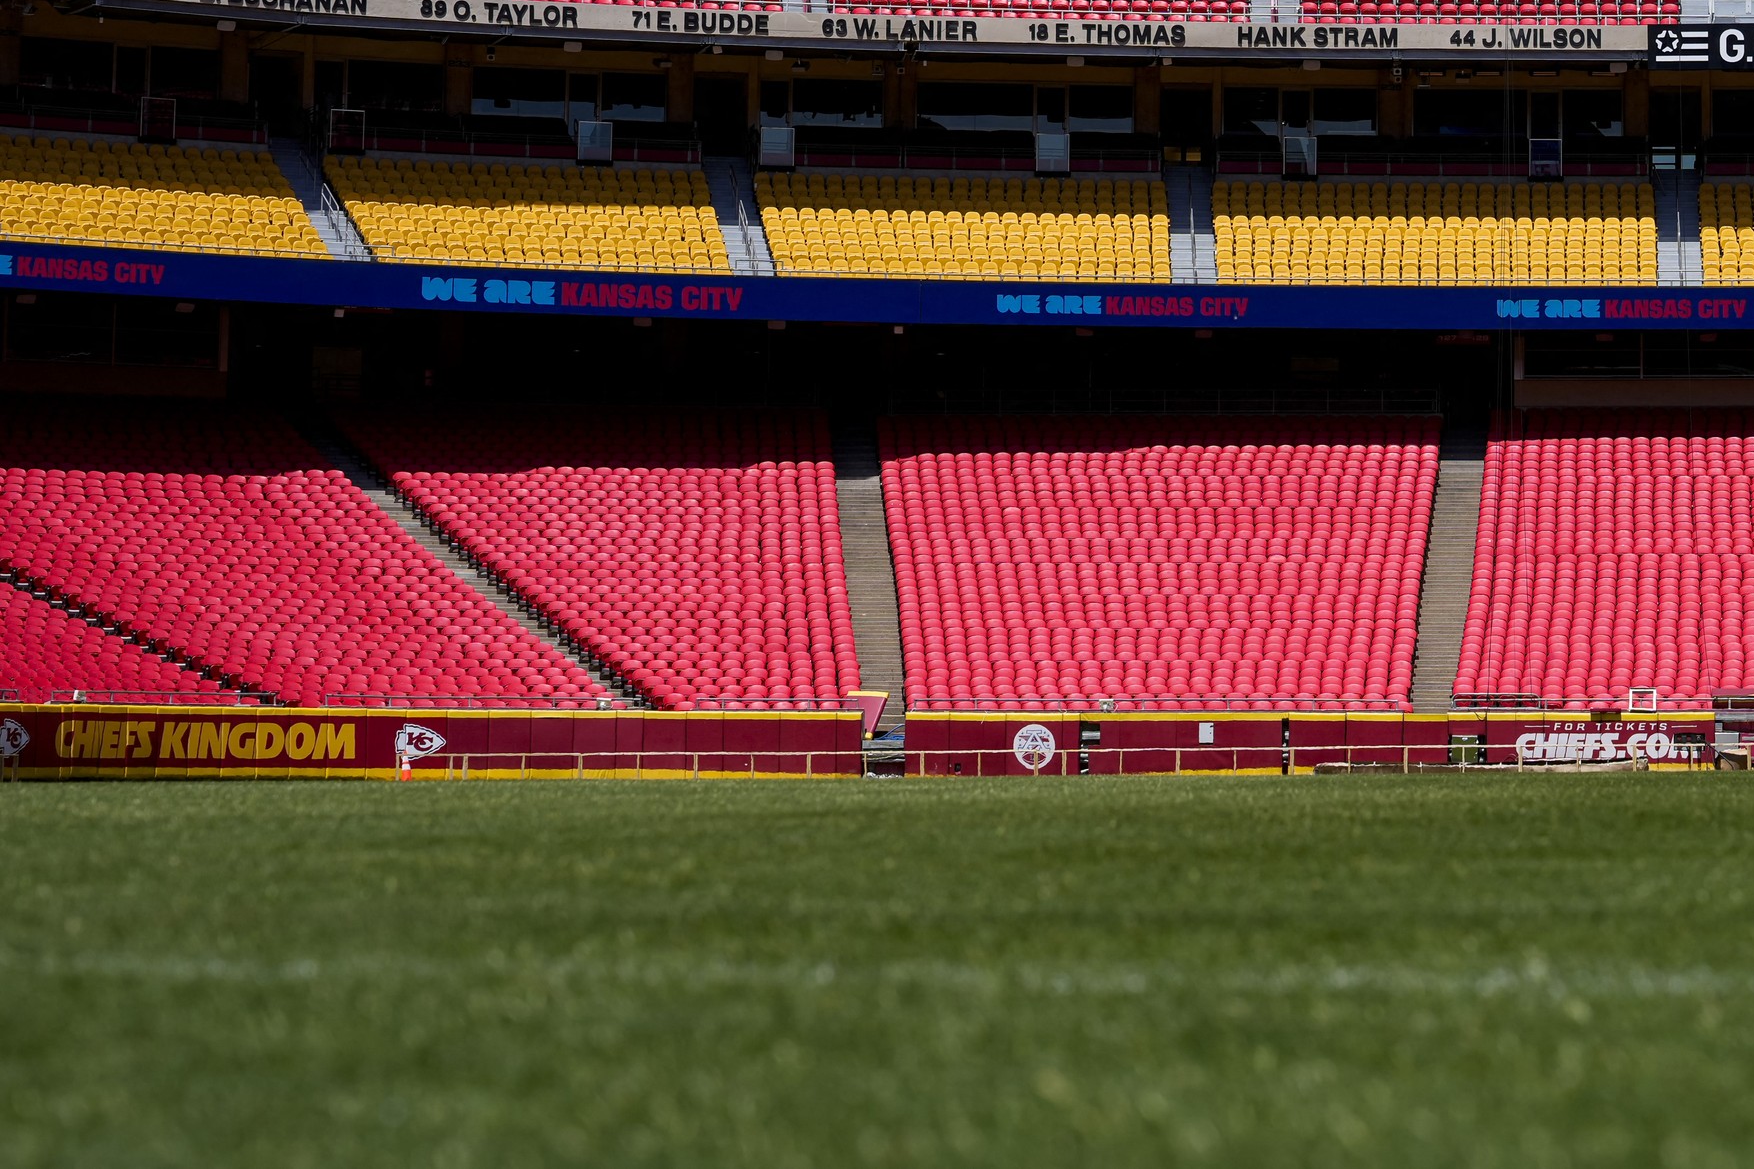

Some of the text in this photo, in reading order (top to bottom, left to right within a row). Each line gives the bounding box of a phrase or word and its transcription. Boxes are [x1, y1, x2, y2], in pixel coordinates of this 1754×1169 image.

[420, 0, 578, 28] 89 O. TAYLOR
[632, 10, 769, 36] 71 E. BUDDE
[822, 18, 978, 42] 63 W. LANIER
[1029, 23, 1186, 47] 18 E. THOMAS
[1237, 26, 1398, 49] HANK STRAM
[1449, 28, 1602, 49] 44 J. WILSON
[17, 255, 109, 282] KANSAS
[114, 261, 165, 285] CITY
[421, 276, 477, 303] WE
[561, 282, 673, 310] KANSAS
[681, 285, 744, 311] CITY
[996, 294, 1041, 315] WE
[1106, 296, 1194, 317] KANSAS
[1200, 296, 1249, 317] CITY
[1496, 299, 1540, 319] WE
[1605, 299, 1693, 319] KANSAS
[1698, 299, 1747, 319] CITY
[1553, 722, 1668, 731] FOR TICKETS
[55, 720, 356, 760] CHIEFS KINGDOM
